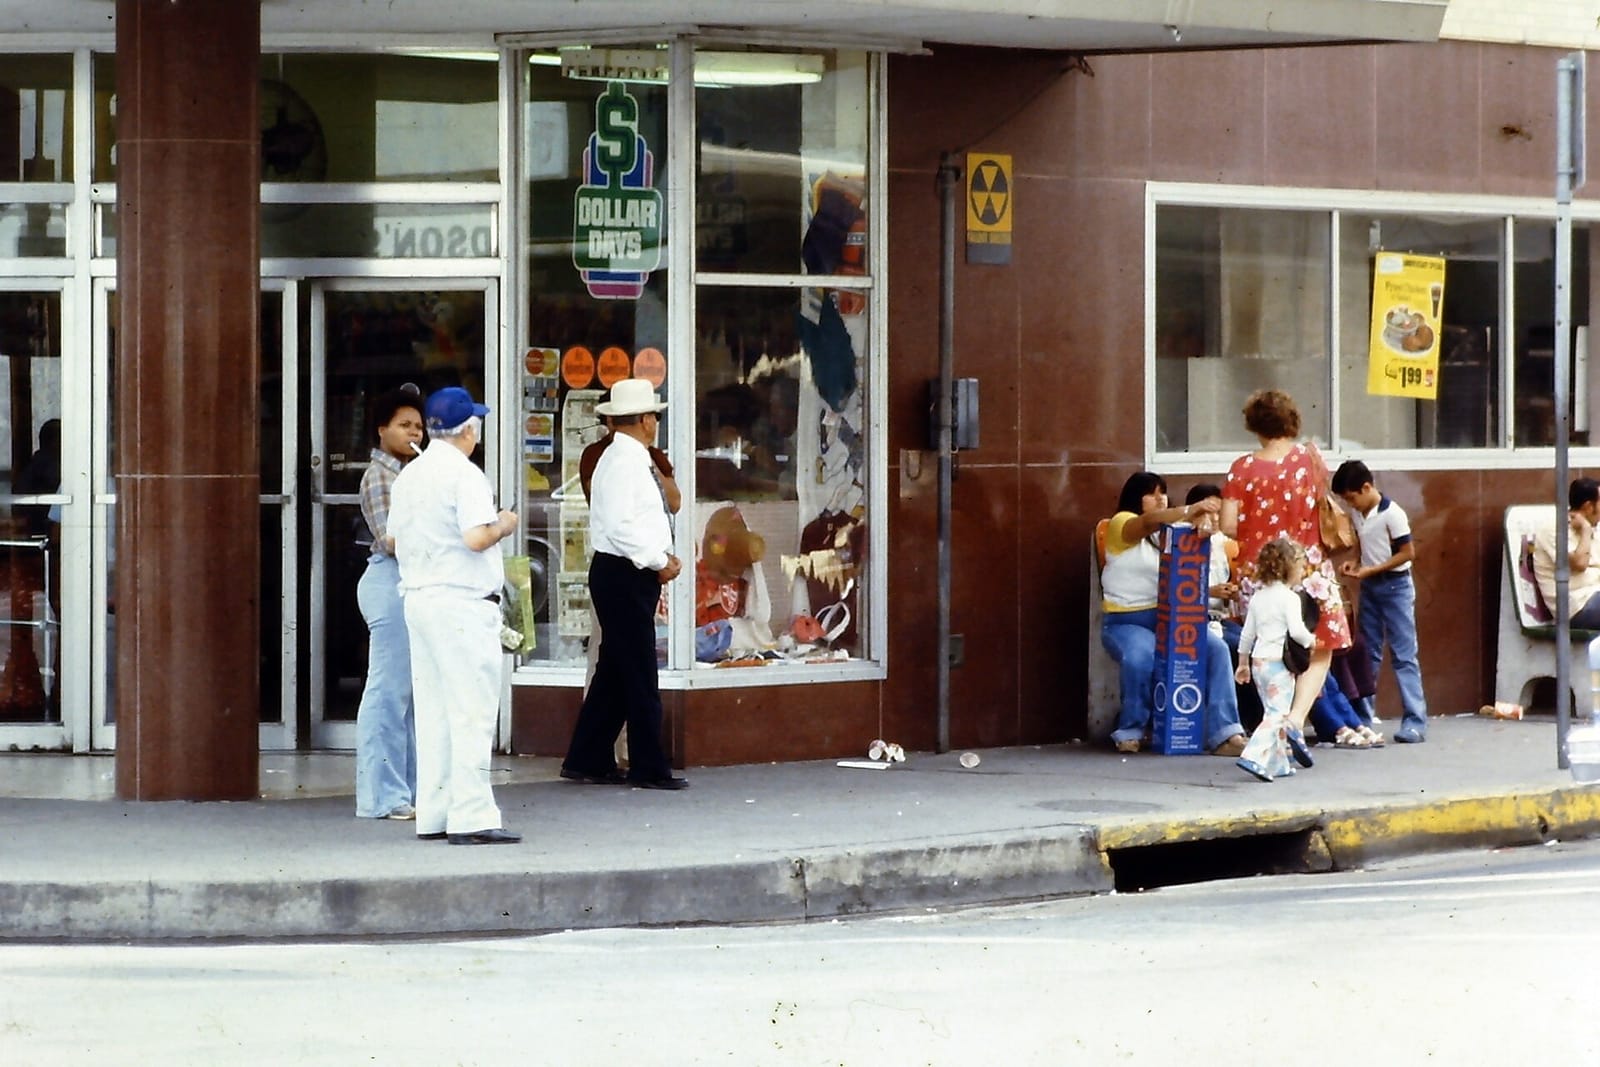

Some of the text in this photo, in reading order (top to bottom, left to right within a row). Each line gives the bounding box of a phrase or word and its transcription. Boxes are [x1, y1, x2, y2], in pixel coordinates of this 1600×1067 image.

[578, 197, 657, 228] DOLLAR
[588, 231, 642, 259] DAYS
[1174, 533, 1206, 660] stroller
